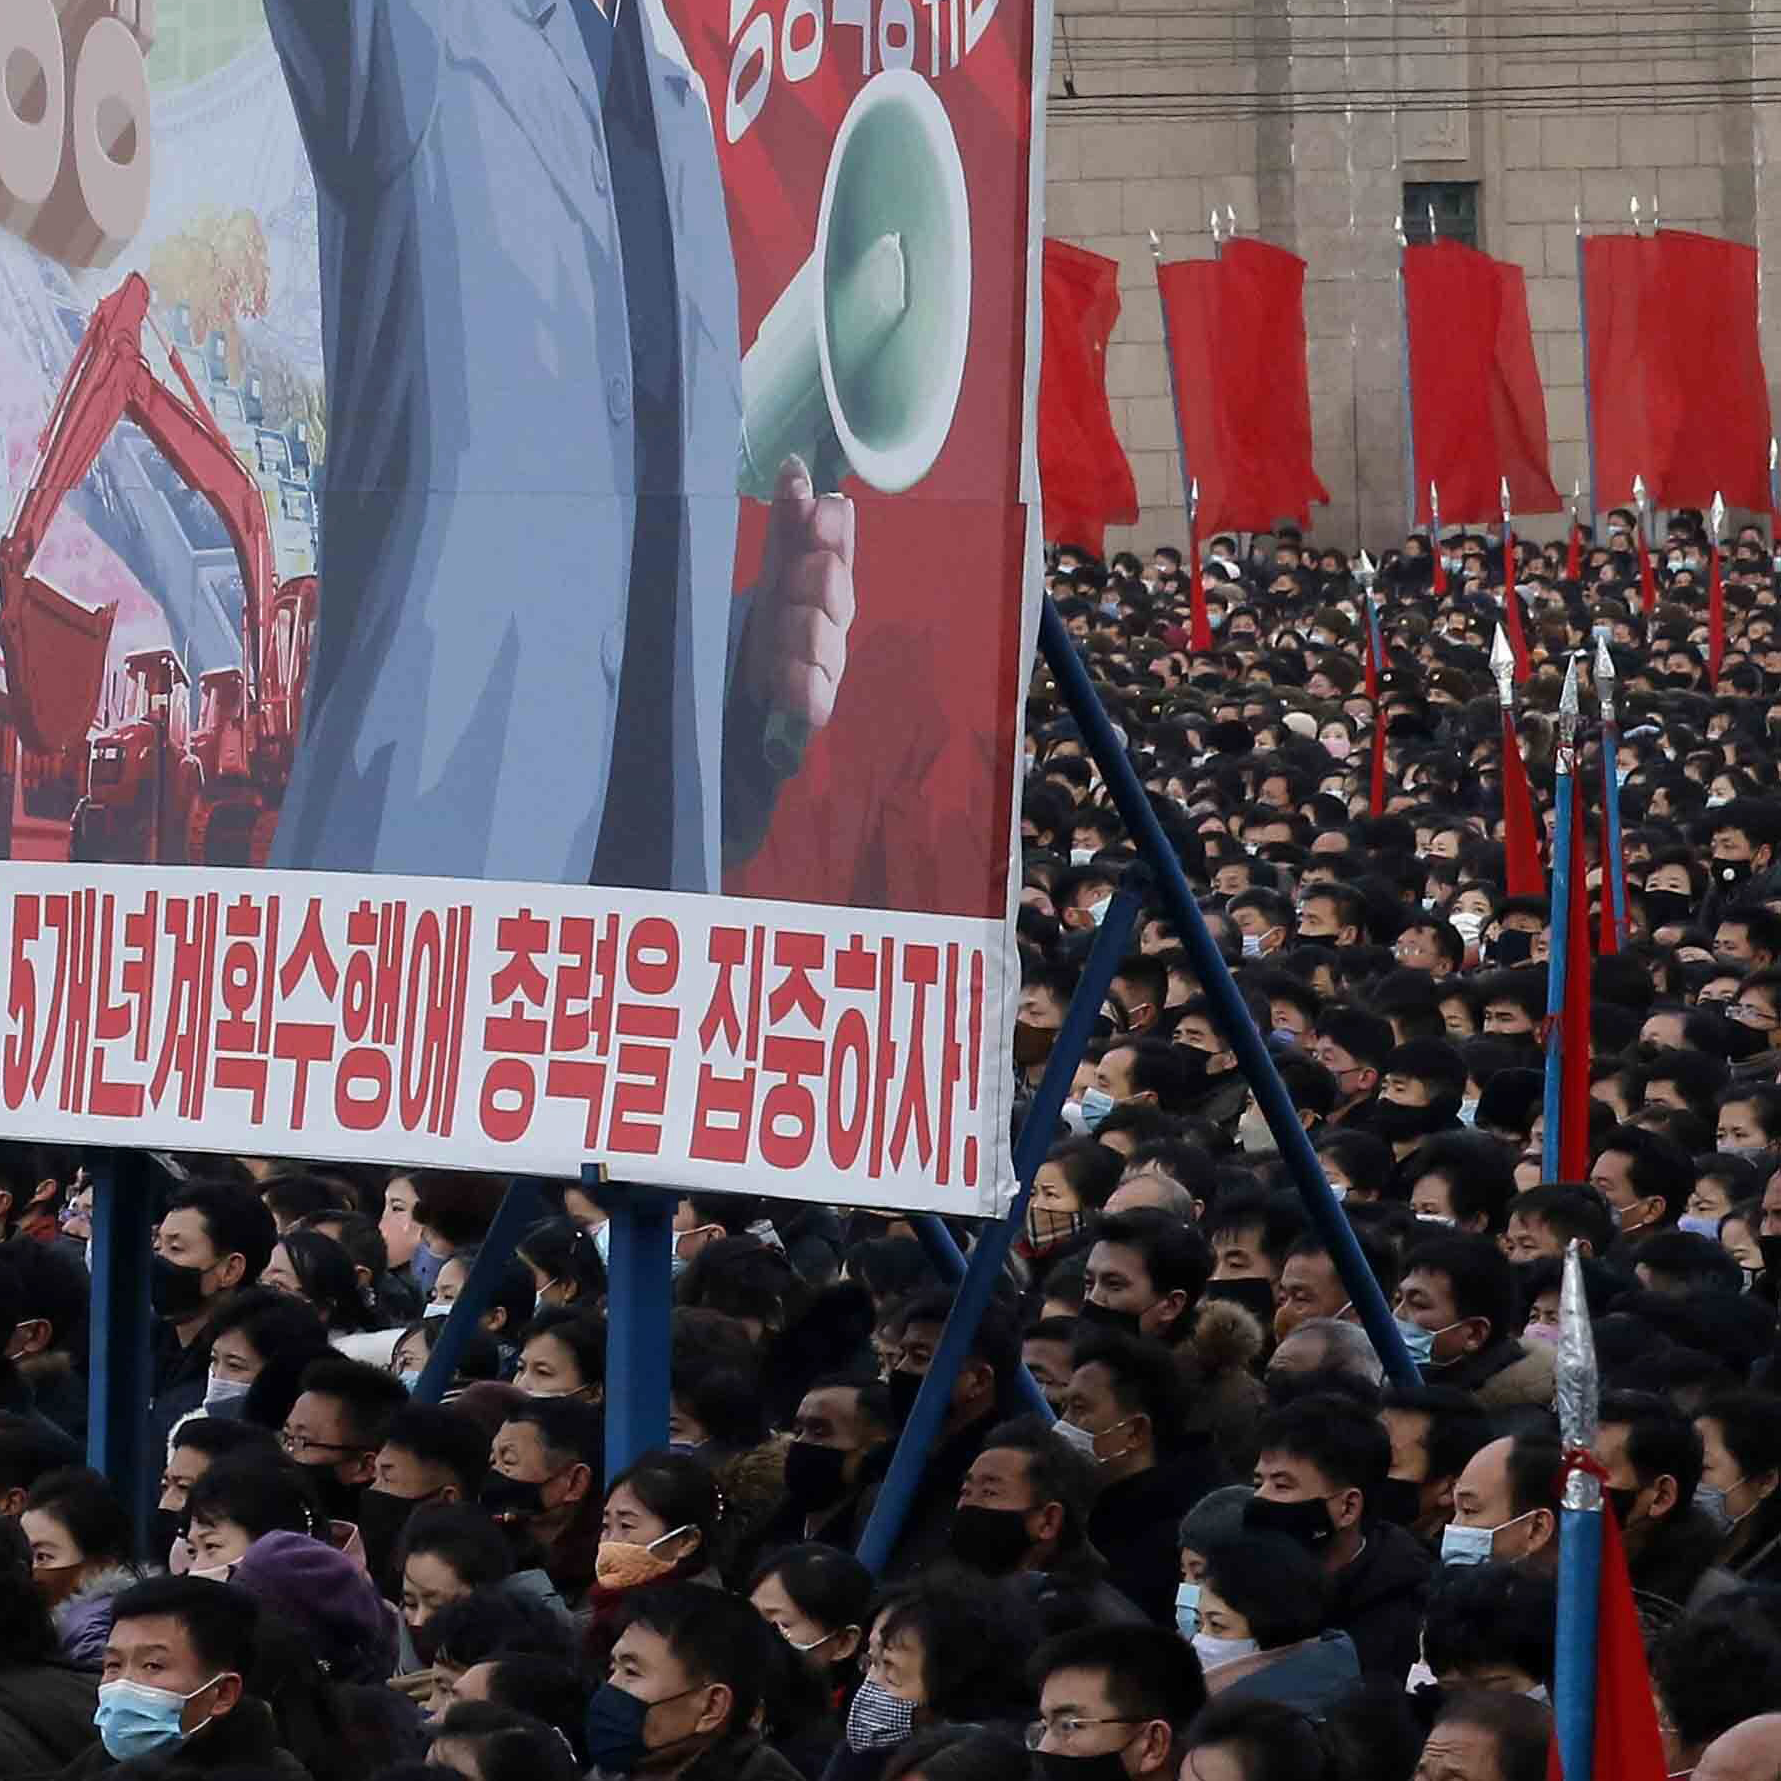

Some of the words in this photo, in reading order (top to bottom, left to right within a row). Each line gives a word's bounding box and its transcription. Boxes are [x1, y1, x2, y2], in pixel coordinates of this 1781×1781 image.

[2, 887, 473, 1139] 5개년계획수행에
[478, 907, 681, 1156] 총력을
[687, 923, 985, 1188] 집중하자!
